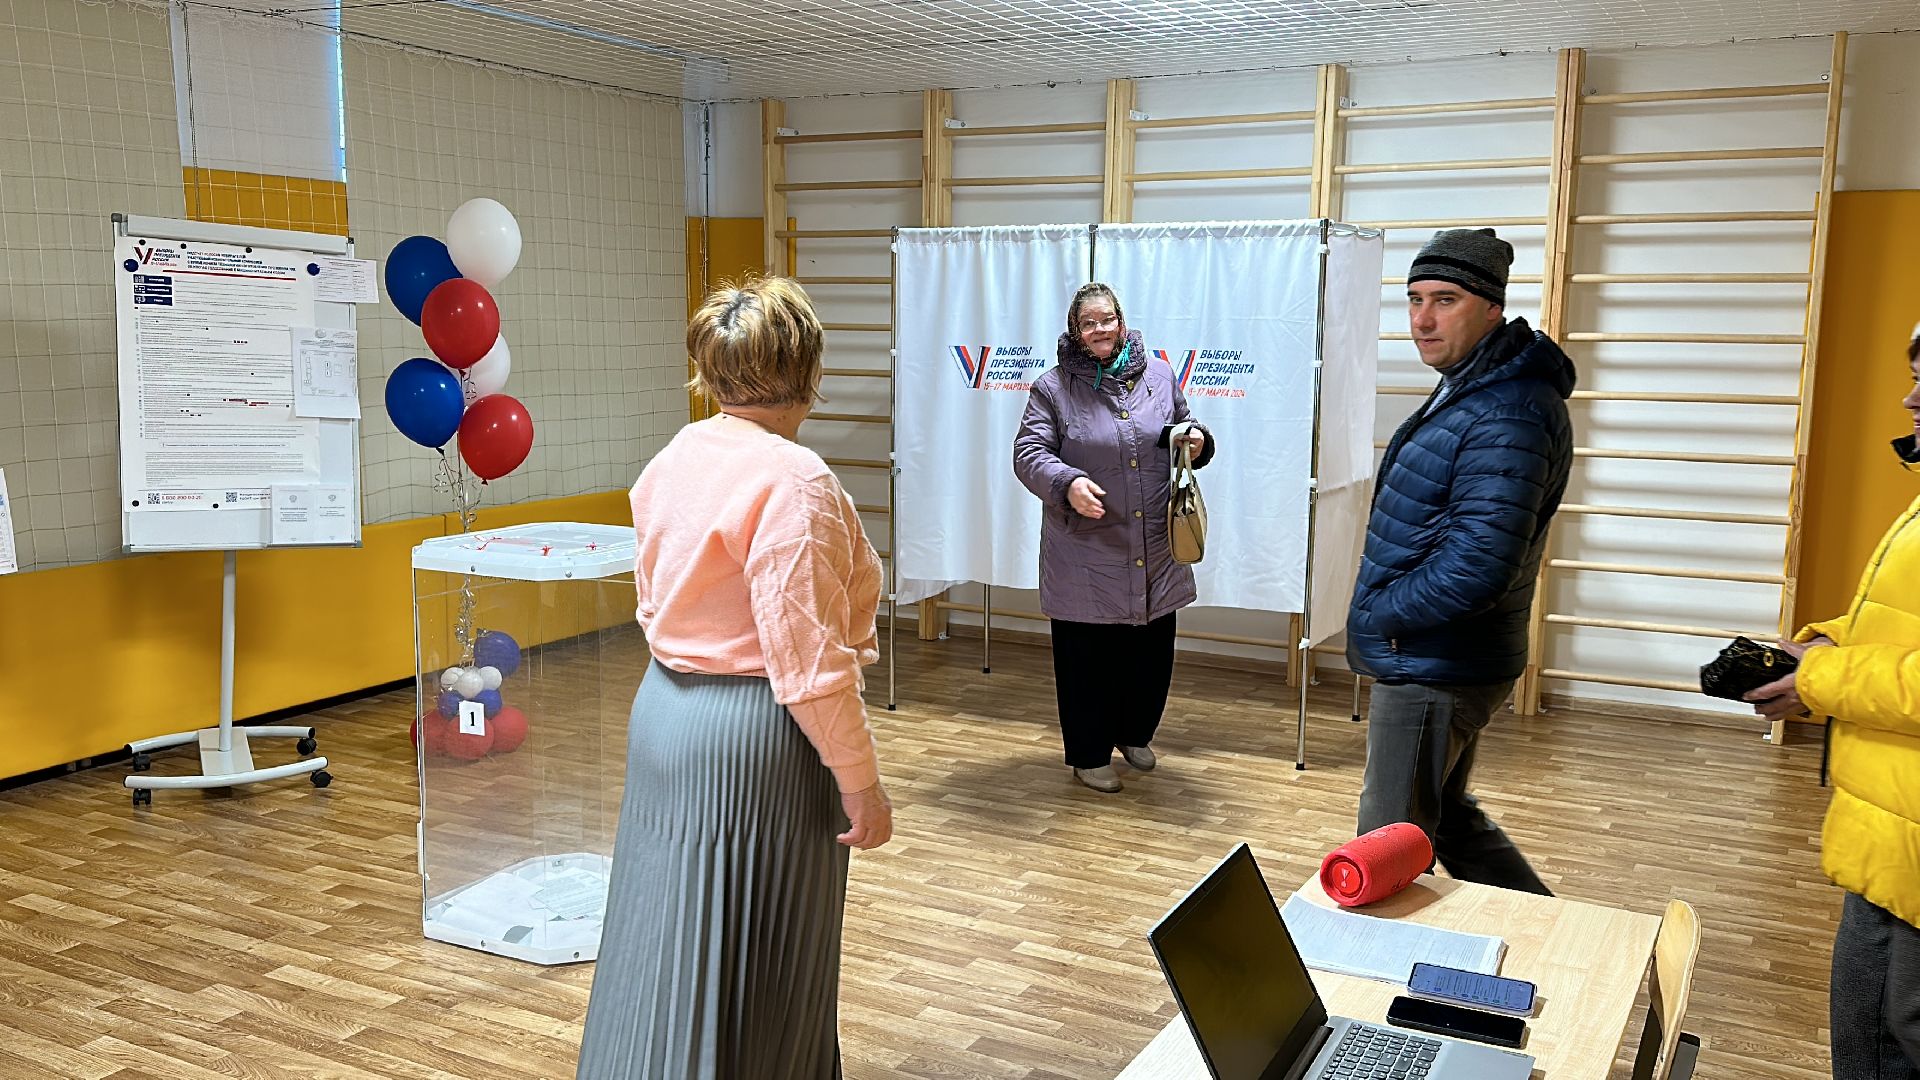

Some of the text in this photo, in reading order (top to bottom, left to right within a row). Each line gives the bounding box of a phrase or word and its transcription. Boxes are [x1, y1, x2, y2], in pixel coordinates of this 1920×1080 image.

[995, 346, 1033, 356] ВЫБОРЫ
[1199, 349, 1243, 361] ВЫБОРЫ
[990, 359, 1046, 370] ПРЕЗИДЕНТА
[1194, 362, 1255, 375] ПРЕЗИДЕНТА
[985, 371, 1023, 380] РОССИИ
[1190, 375, 1231, 386] РОССИИ
[470, 712, 475, 726] 1
